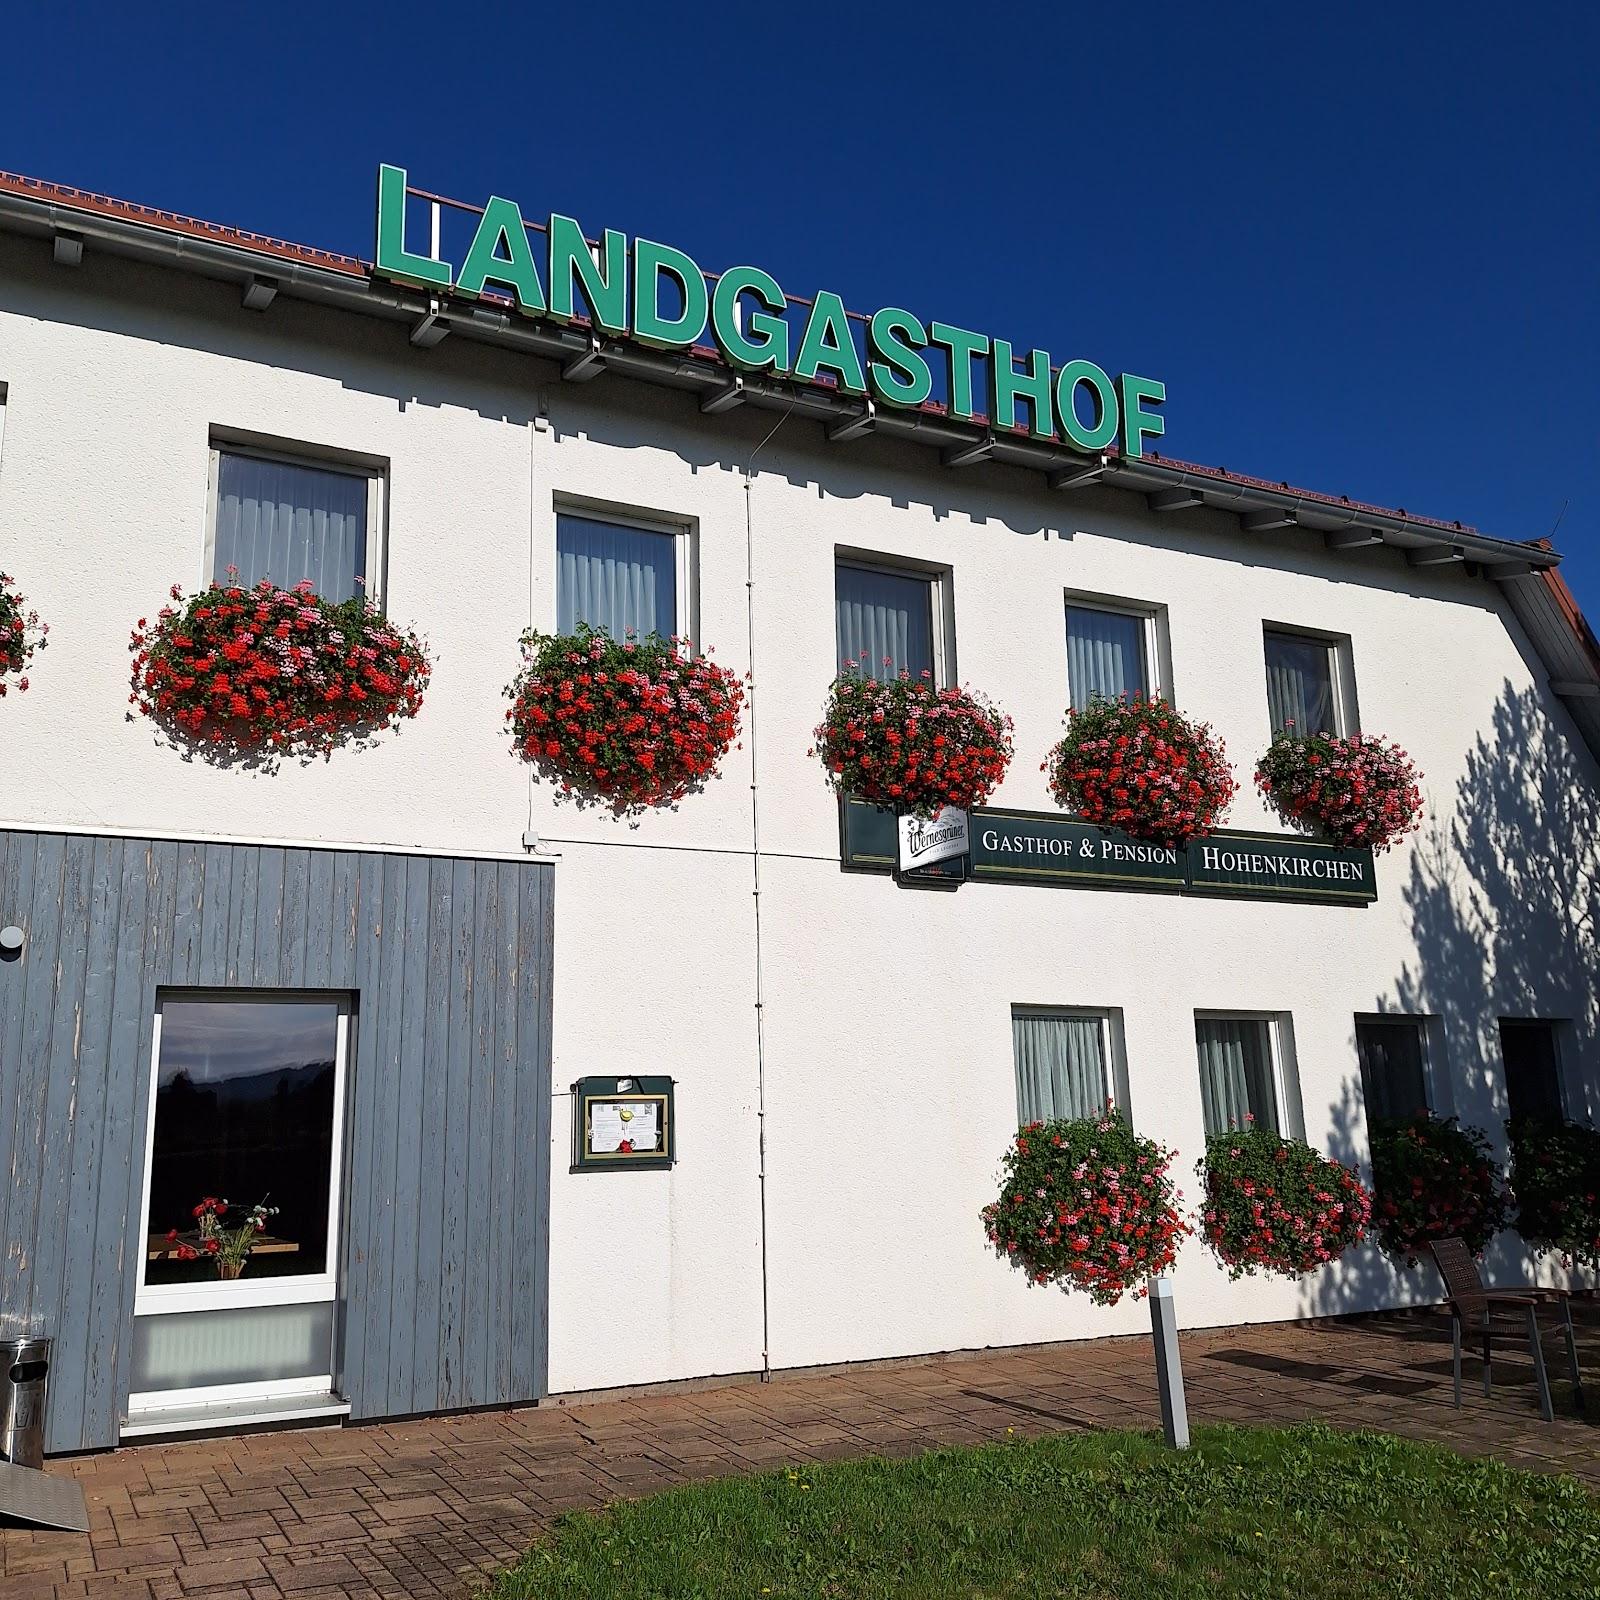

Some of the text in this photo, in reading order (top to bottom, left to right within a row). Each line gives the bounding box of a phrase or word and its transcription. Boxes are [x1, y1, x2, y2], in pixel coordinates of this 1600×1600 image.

[375, 163, 1166, 462] LANDGASTHOF
[982, 830, 1073, 857] GASTHOF
[1079, 837, 1096, 859] &
[1101, 839, 1177, 865] PENSION
[1201, 846, 1363, 881] HOHENKIRCHEN
